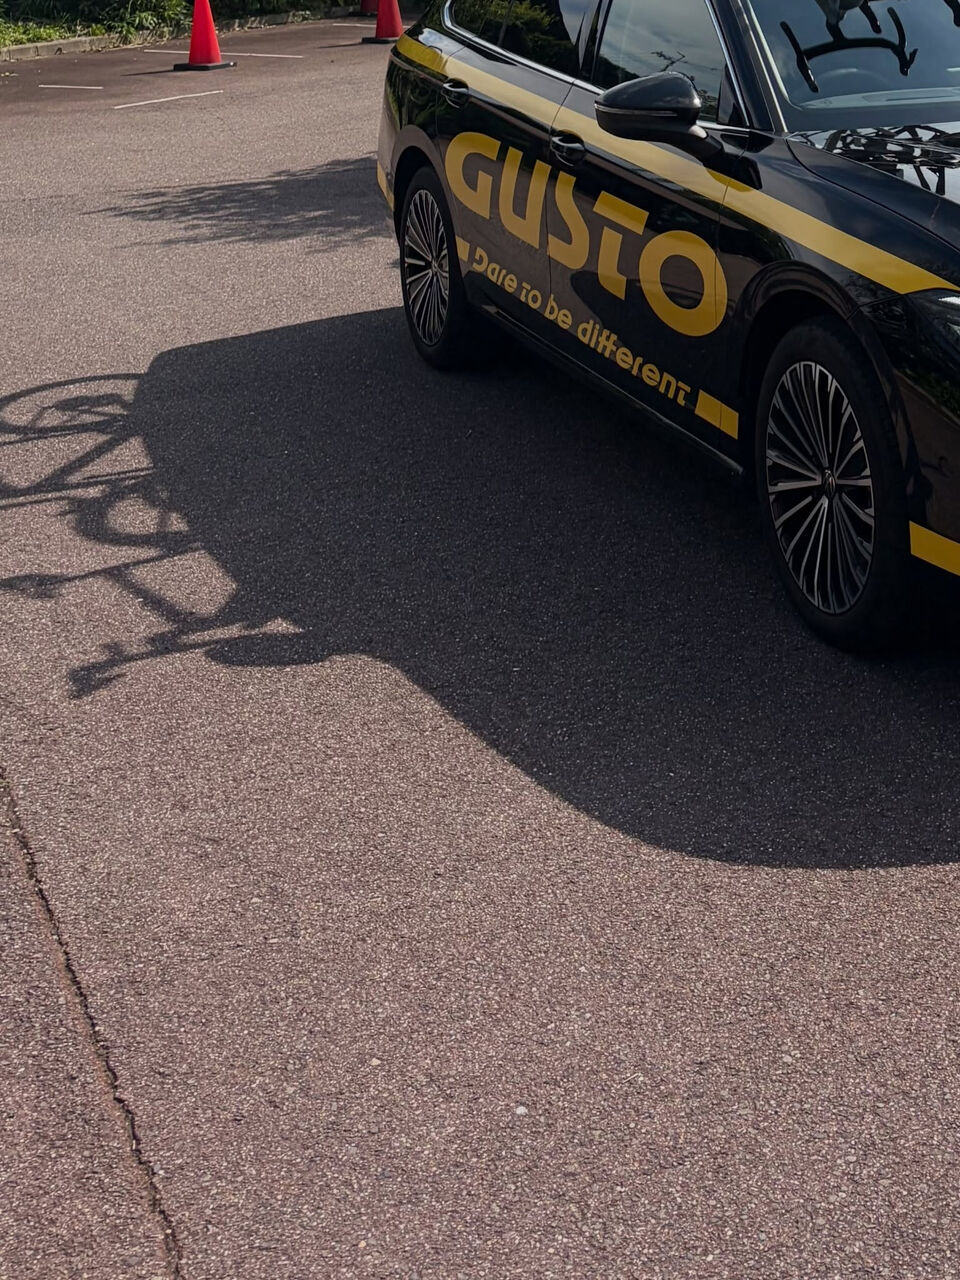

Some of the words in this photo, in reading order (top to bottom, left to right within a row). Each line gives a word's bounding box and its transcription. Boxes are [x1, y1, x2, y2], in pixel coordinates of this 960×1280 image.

[444, 131, 728, 337] GUSTO
[472, 247, 518, 293] Dare
[520, 282, 543, 310] to
[544, 294, 573, 330] be
[577, 319, 691, 406] different
